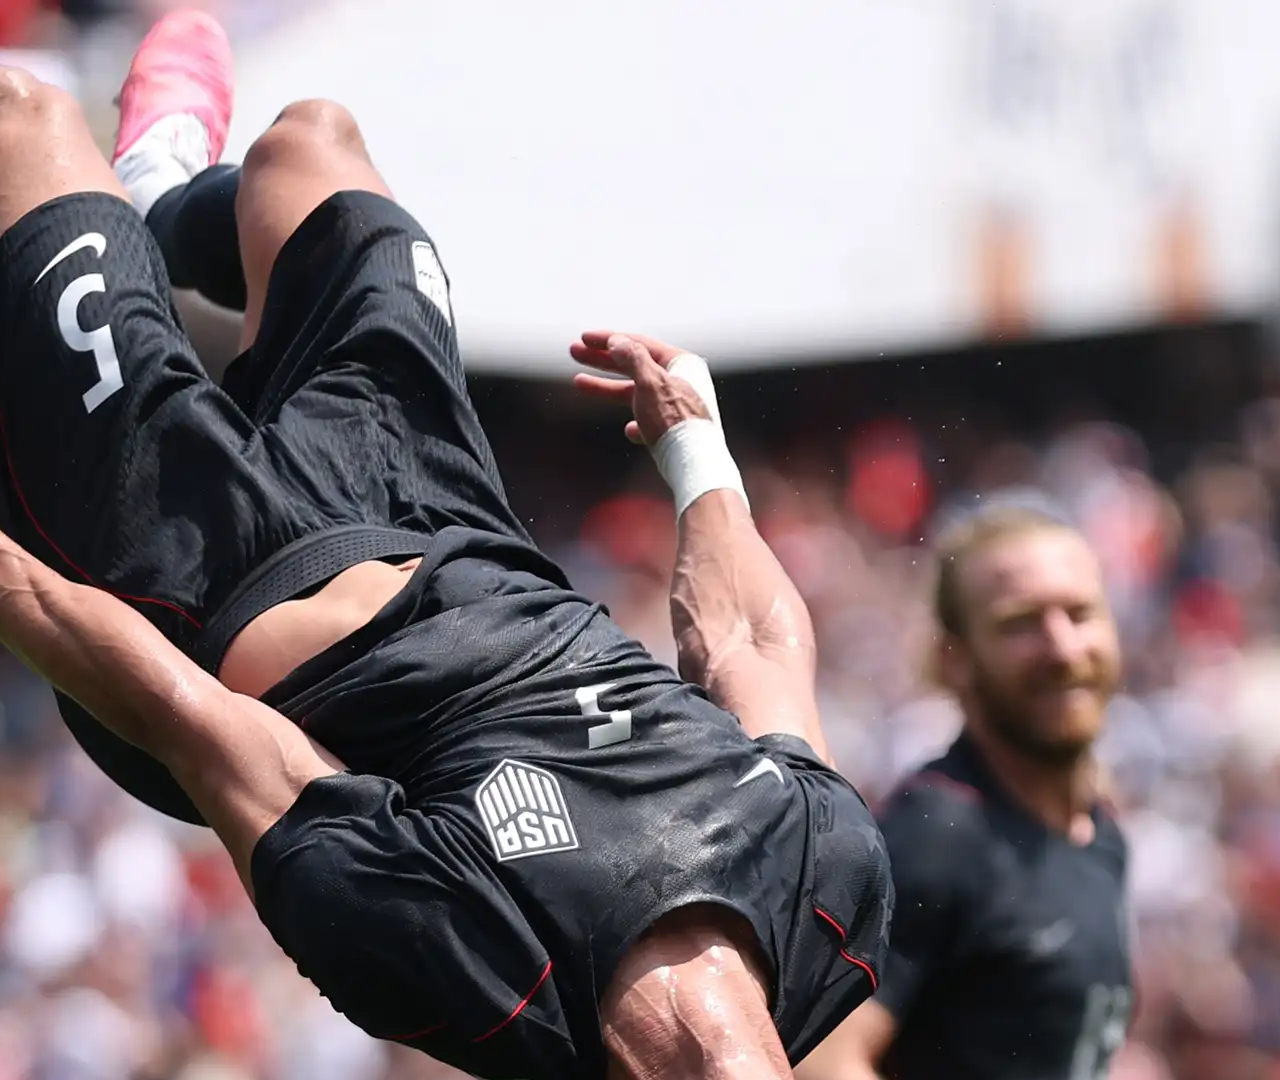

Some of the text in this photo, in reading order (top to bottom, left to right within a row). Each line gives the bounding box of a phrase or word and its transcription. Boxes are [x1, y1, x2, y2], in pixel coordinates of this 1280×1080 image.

[56, 273, 124, 414] 5
[575, 683, 631, 749] 5
[497, 811, 570, 853] USA
